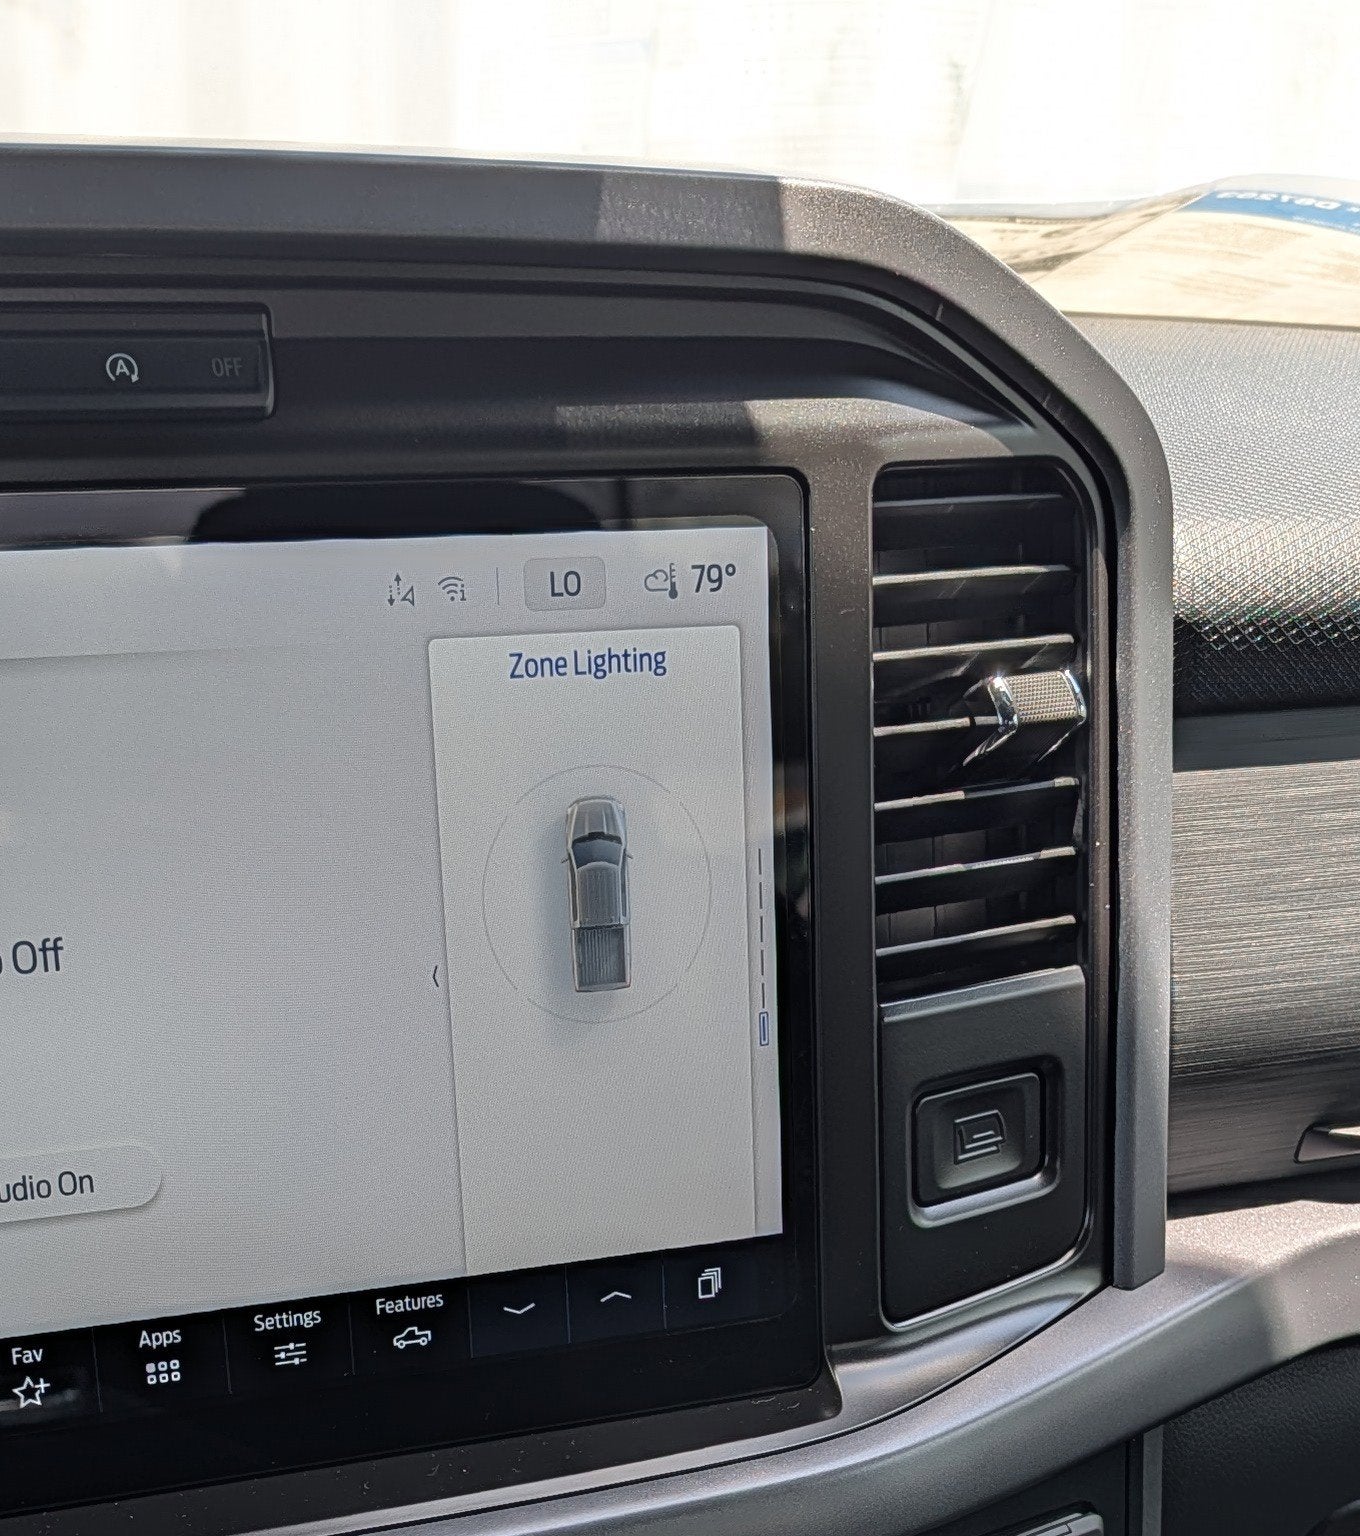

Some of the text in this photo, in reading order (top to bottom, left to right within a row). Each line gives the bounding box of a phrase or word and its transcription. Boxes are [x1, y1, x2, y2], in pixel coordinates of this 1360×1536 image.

[211, 357, 242, 377] OFF
[549, 569, 582, 599] LO
[508, 646, 667, 679] Zone Lighting
[11, 936, 64, 976] Off
[58, 1170, 94, 1198] On
[375, 1290, 444, 1315] Features
[253, 1306, 322, 1332] Settings
[138, 1326, 182, 1350] Apps
[11, 1345, 44, 1367] Fav
